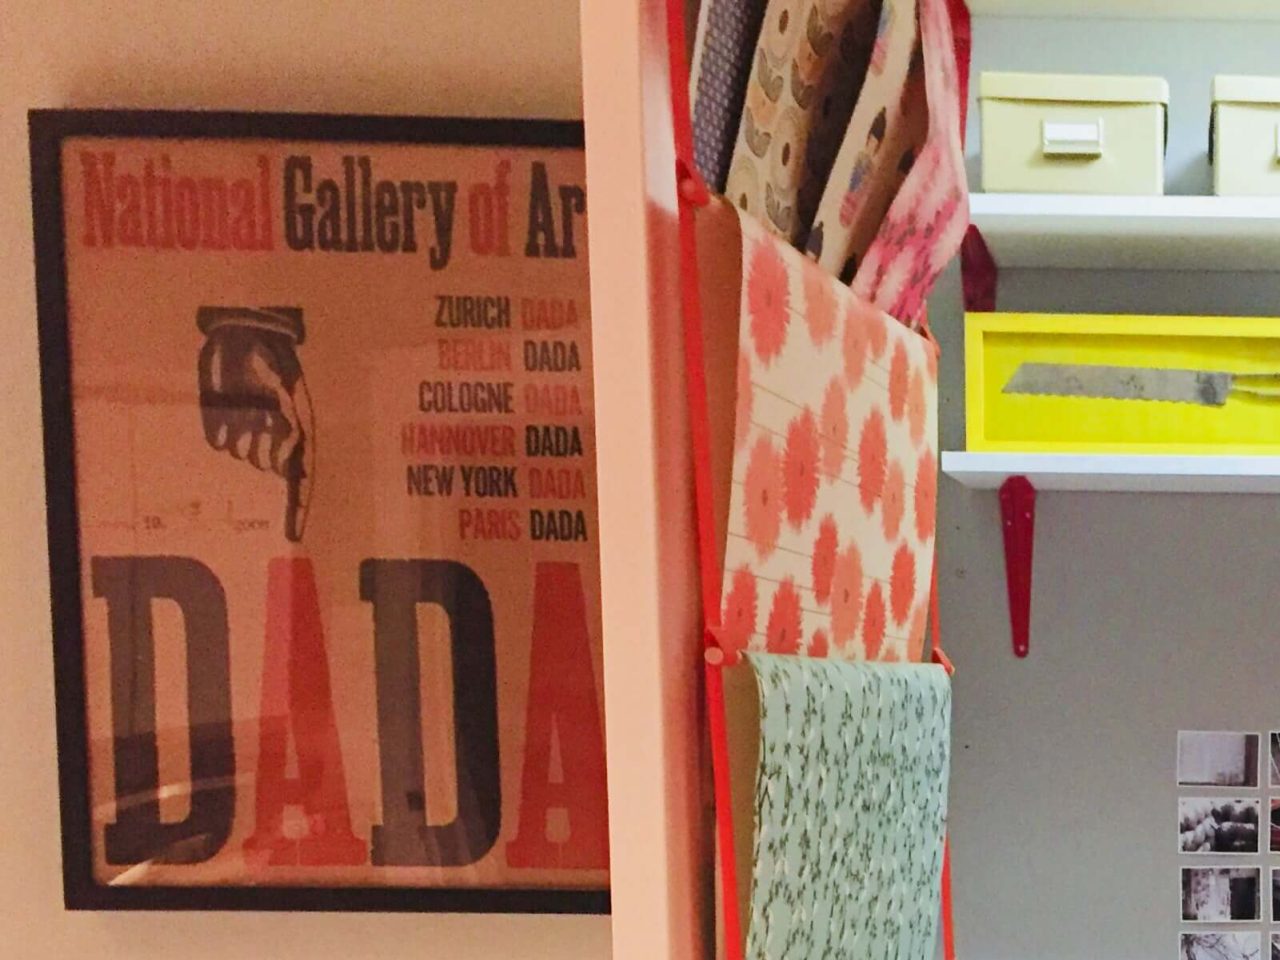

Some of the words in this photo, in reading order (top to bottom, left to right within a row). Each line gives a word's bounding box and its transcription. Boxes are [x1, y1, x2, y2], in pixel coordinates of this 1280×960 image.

[80, 152, 274, 253] National
[283, 155, 458, 270] Gallery
[469, 160, 512, 256] of
[525, 161, 585, 258] Ar
[435, 296, 511, 329] ZURICH
[523, 298, 578, 330] DADA
[437, 340, 512, 372] BERLIN
[524, 340, 581, 372] DADA
[418, 382, 515, 414] COLOGNE
[525, 383, 584, 415] DADA
[401, 425, 516, 456] HANNOVER
[526, 426, 583, 457] DADA
[407, 465, 455, 497] NEW
[457, 465, 518, 497] YORK
[528, 467, 587, 499] DADA
[458, 508, 523, 541] PARIS
[530, 510, 588, 542] DADA
[90, 553, 611, 870] DADA
